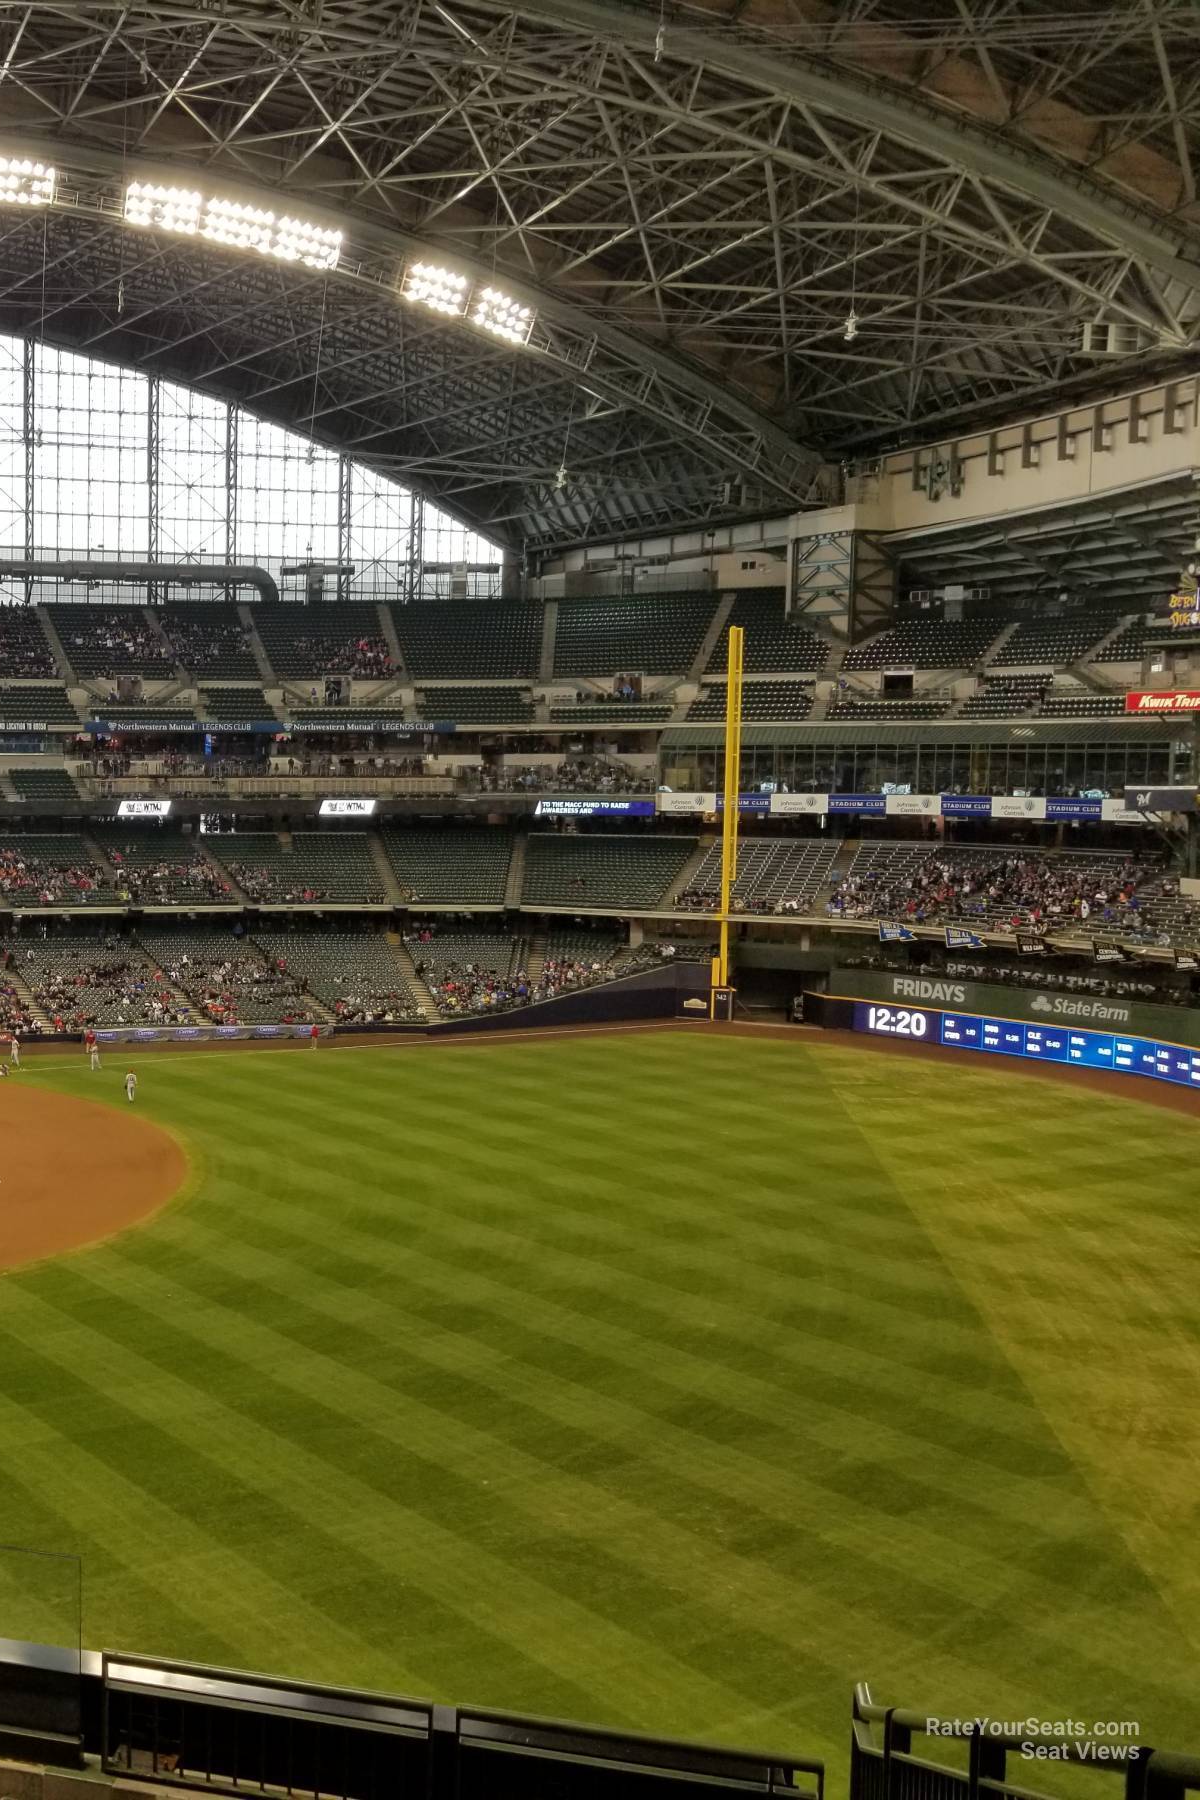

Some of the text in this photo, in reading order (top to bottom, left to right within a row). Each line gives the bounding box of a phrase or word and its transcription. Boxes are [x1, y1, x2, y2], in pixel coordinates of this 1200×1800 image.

[1138, 695, 1173, 708] KWIK
[118, 723, 251, 731] Northwestern Mutual LEGENDS CLUB
[293, 723, 435, 731] Northwestern Mutual LEGENDS CLUB
[893, 978, 966, 1003] FRIDAYS
[715, 993, 727, 1001] 342
[868, 1007, 927, 1037] 12:20
